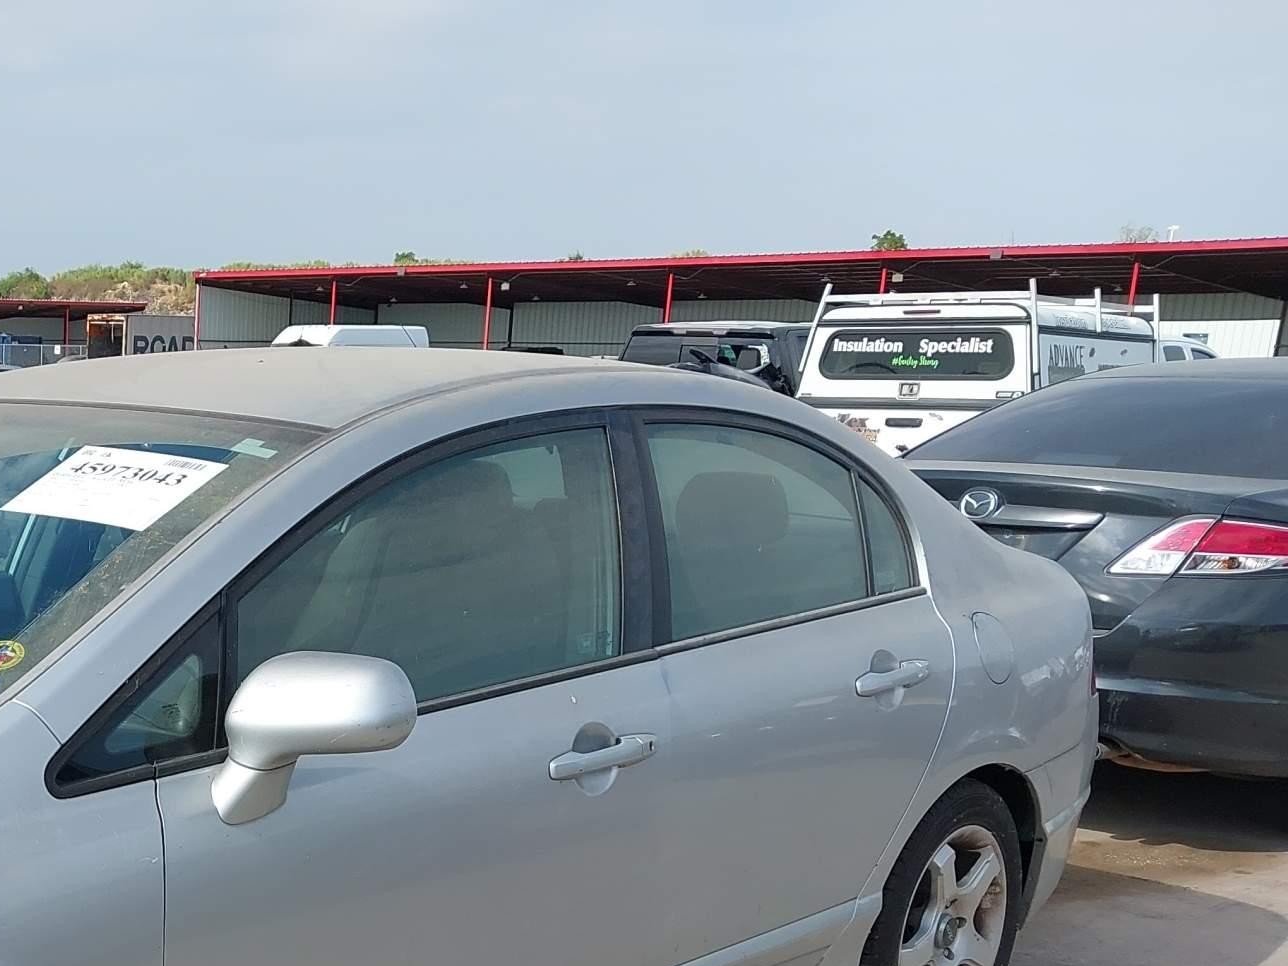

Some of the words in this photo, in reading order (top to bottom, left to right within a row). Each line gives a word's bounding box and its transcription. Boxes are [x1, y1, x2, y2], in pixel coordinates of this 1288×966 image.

[832, 337, 904, 353] Insulation
[919, 337, 994, 357] Specialist
[1048, 343, 1086, 368] ADVANCE
[70, 461, 188, 486] 45973043
